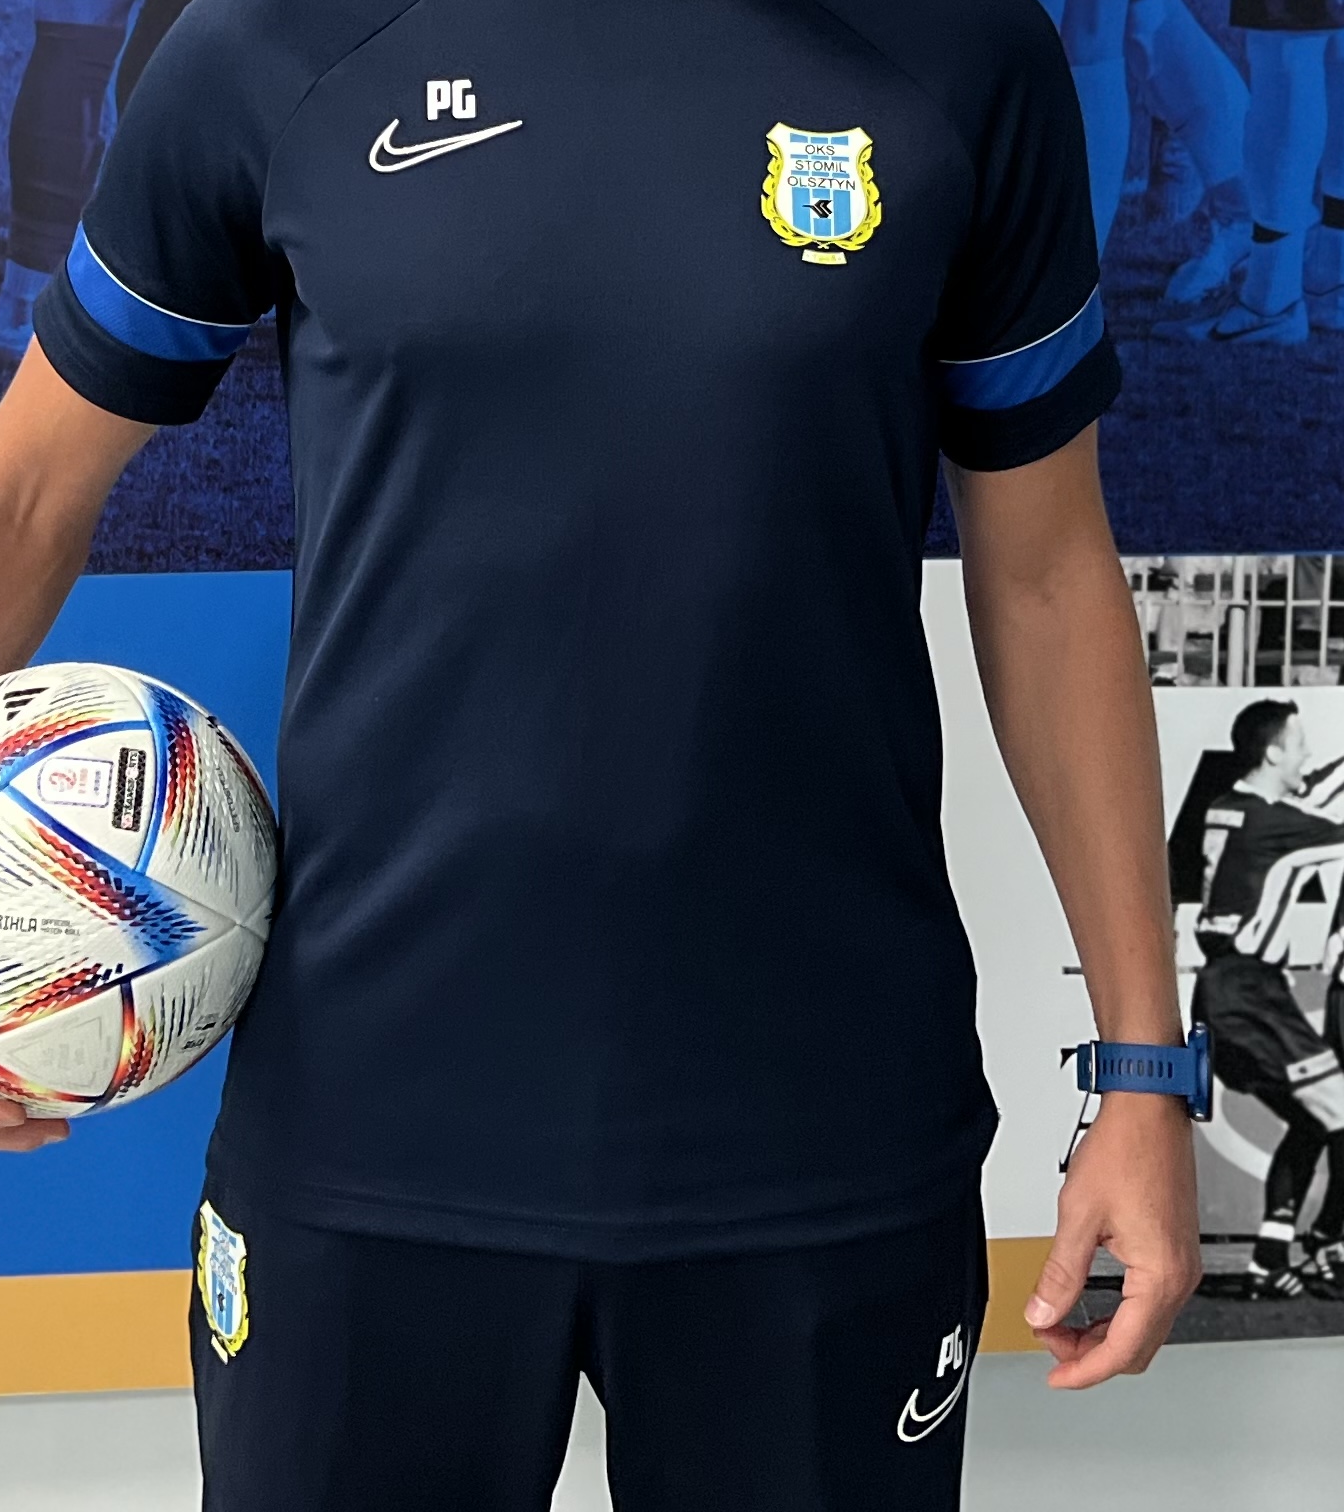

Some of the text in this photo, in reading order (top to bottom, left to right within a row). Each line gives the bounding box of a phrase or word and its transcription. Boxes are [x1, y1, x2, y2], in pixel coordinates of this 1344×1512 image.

[426, 79, 476, 120] PG
[805, 144, 835, 156] OKS
[795, 160, 846, 173] STOMIL
[787, 175, 856, 191] OLSZTYN
[936, 1323, 963, 1378] PG
